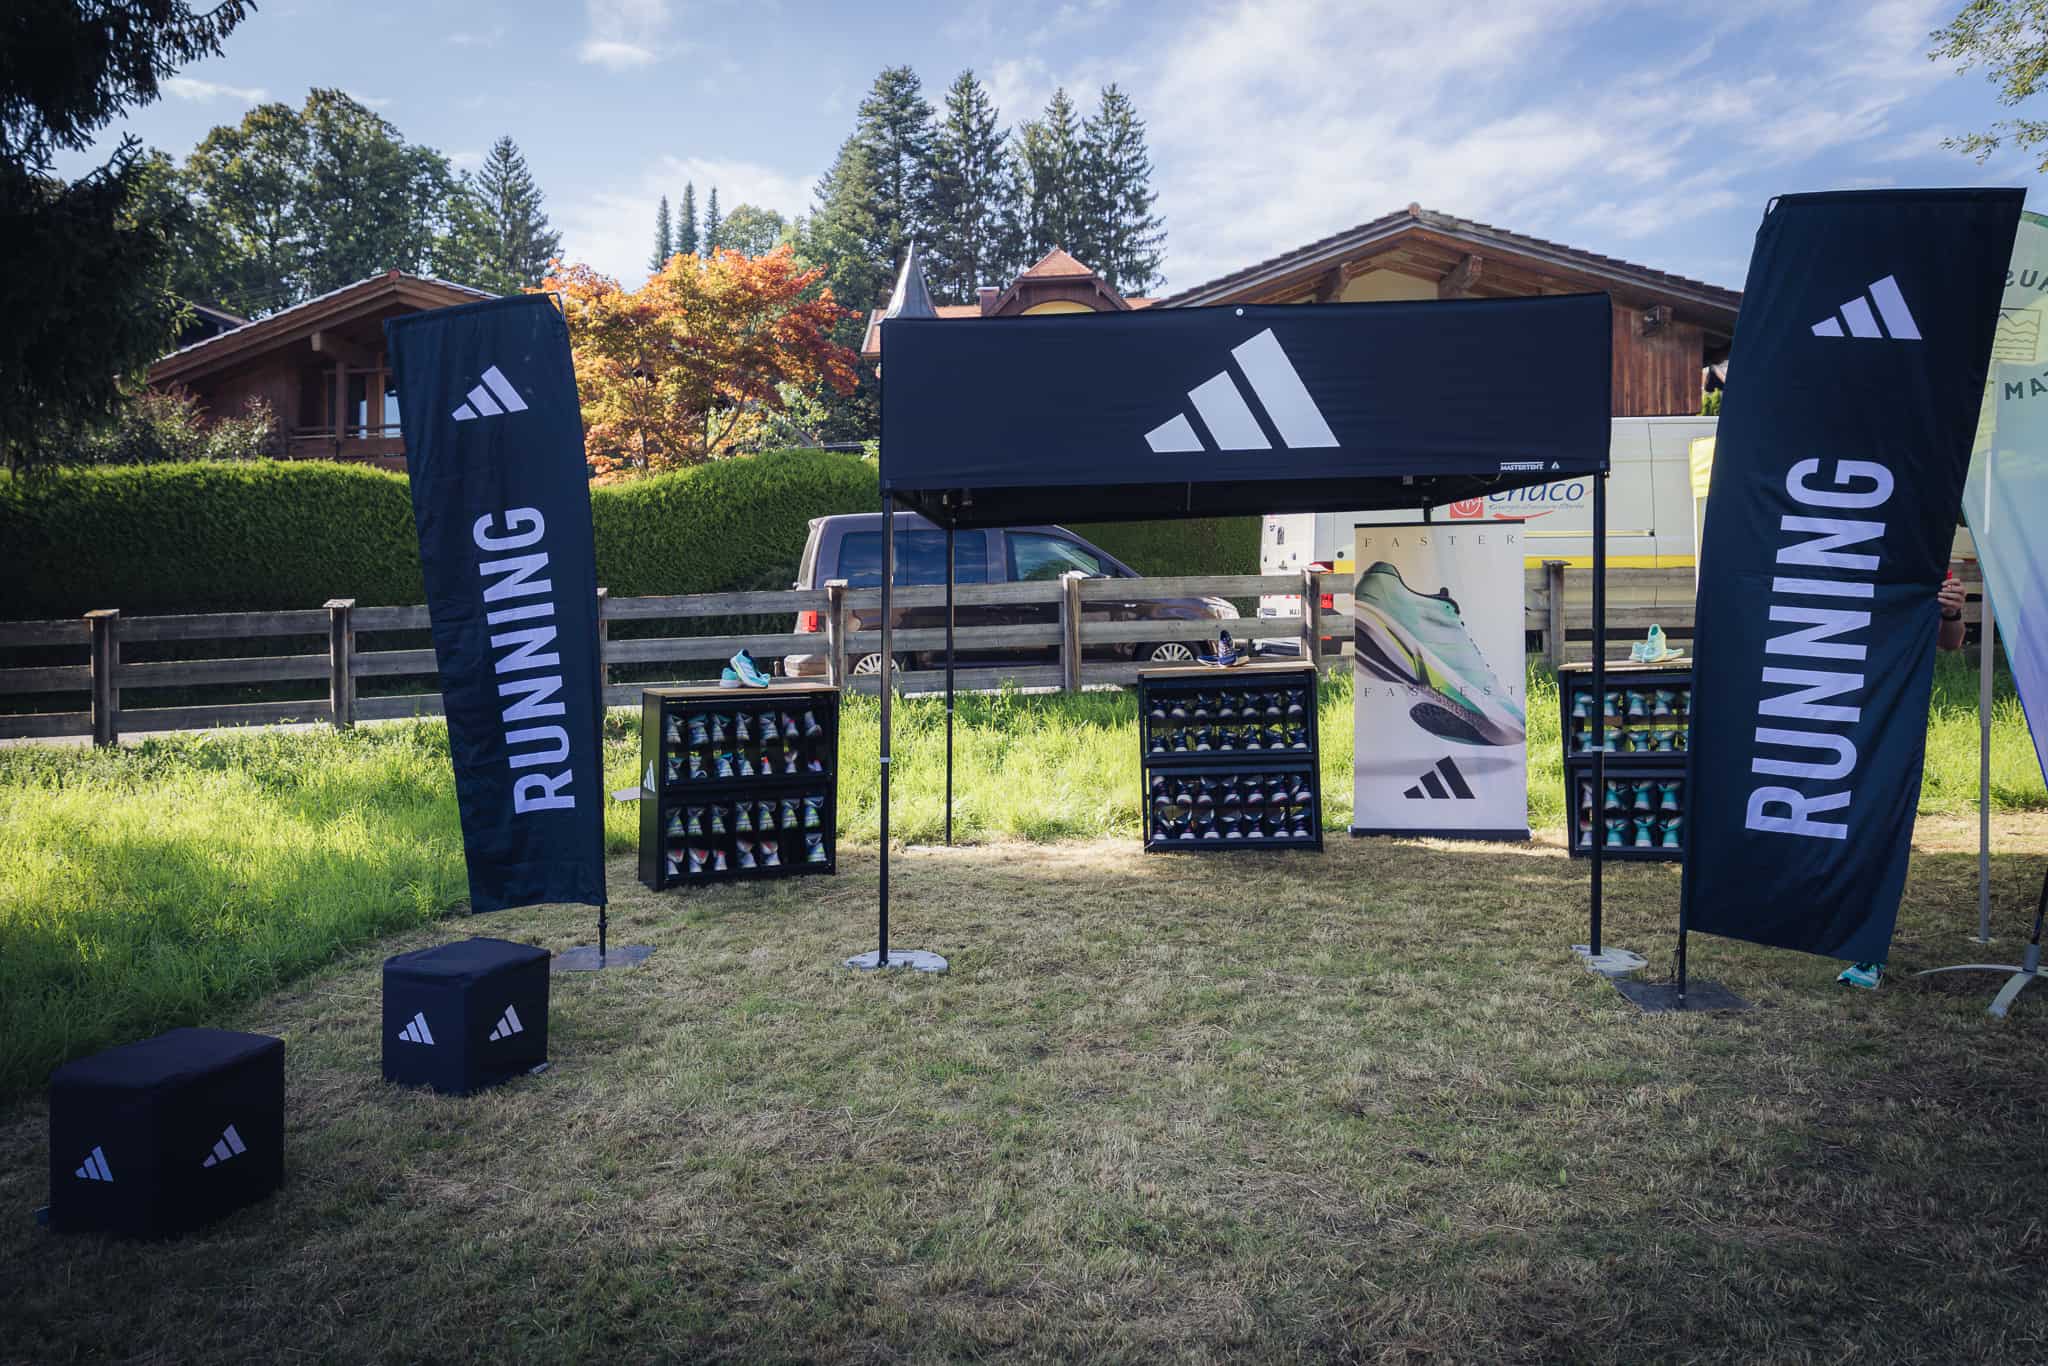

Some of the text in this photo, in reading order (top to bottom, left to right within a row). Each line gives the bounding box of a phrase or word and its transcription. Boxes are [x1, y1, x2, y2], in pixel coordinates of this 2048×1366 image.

[473, 507, 575, 814] RUNNING
[1364, 535, 1515, 548] FASTER
[1744, 457, 1894, 839] RUNNING
